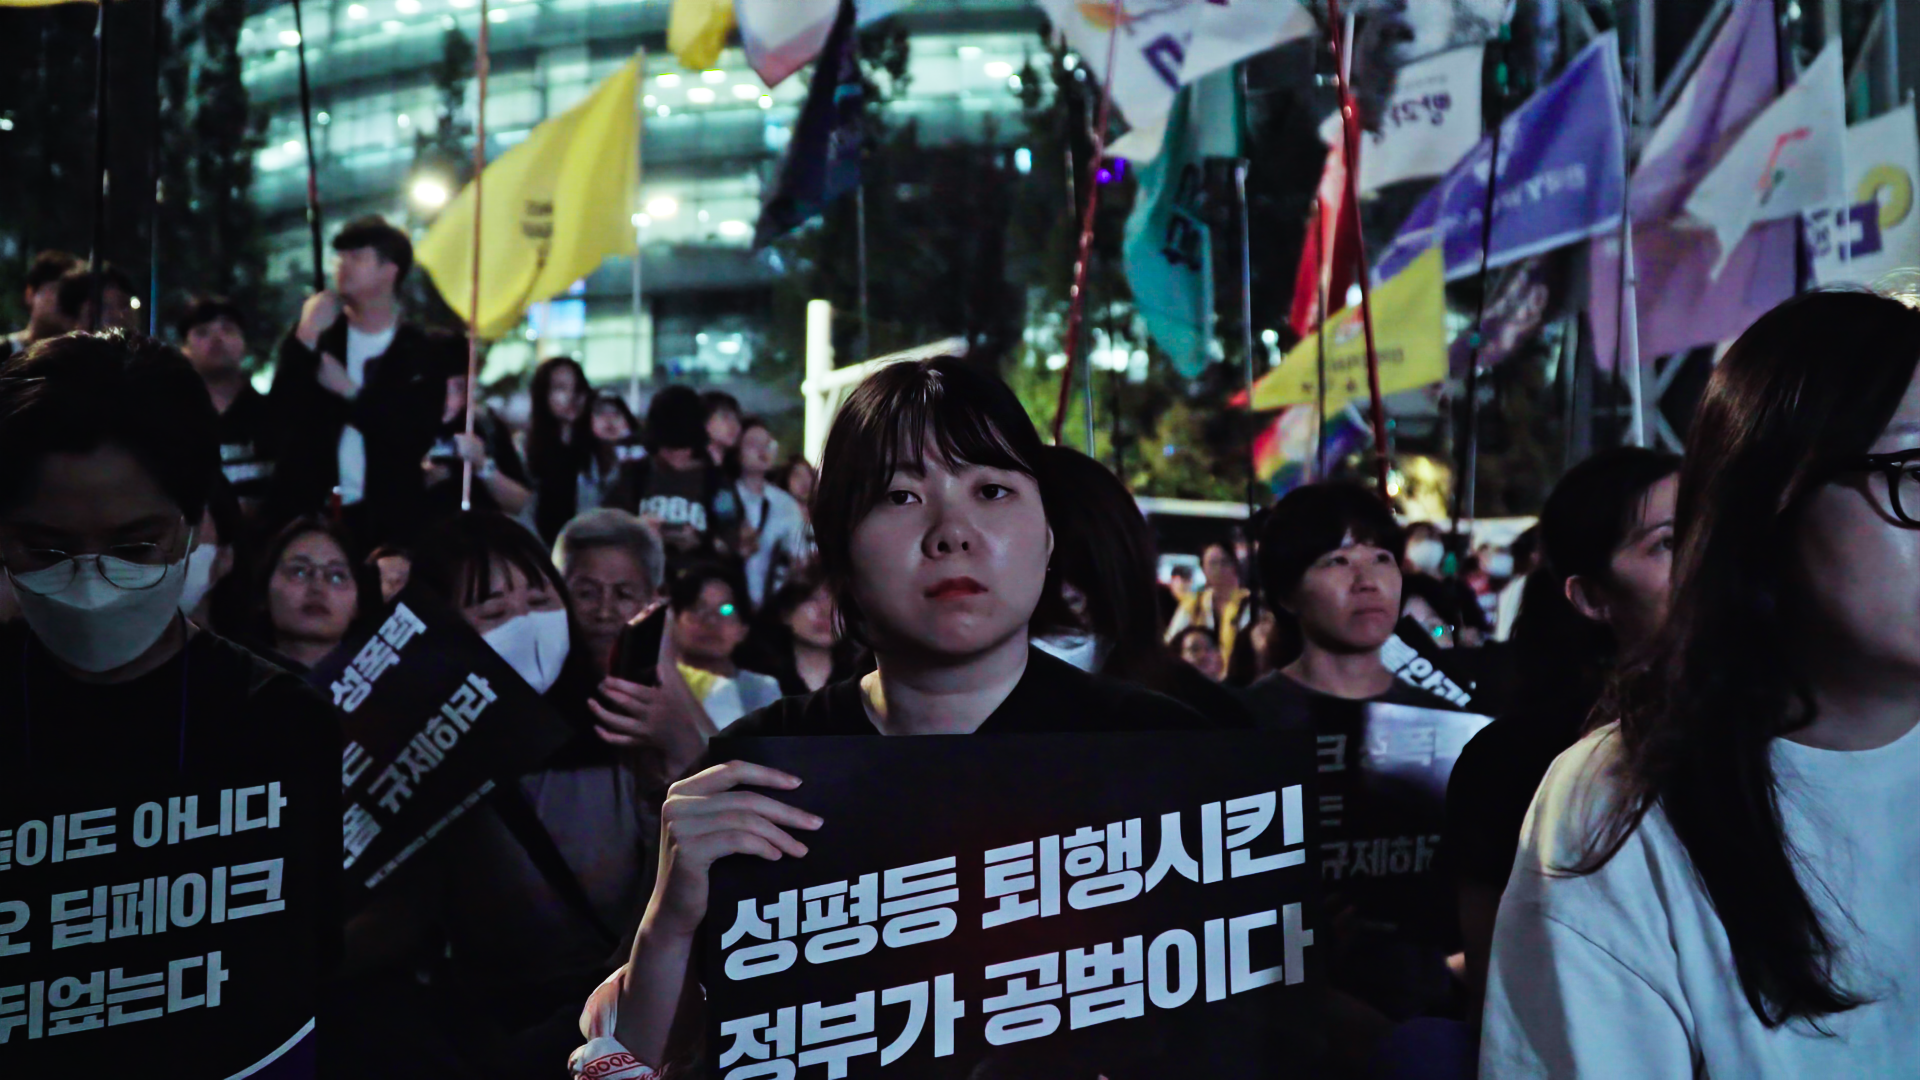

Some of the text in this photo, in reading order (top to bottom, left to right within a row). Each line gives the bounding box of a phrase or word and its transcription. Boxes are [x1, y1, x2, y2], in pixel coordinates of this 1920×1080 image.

[329, 601, 428, 714] 성폭력
[367, 672, 499, 814] 규제하라
[132, 781, 288, 848] 아니다
[51, 857, 286, 950] 딥페이크
[720, 784, 1306, 980] 성평등 퇴행시킨
[0, 950, 230, 1044] 뒤엎는다
[718, 902, 1315, 1080] 정부가 공범이다
